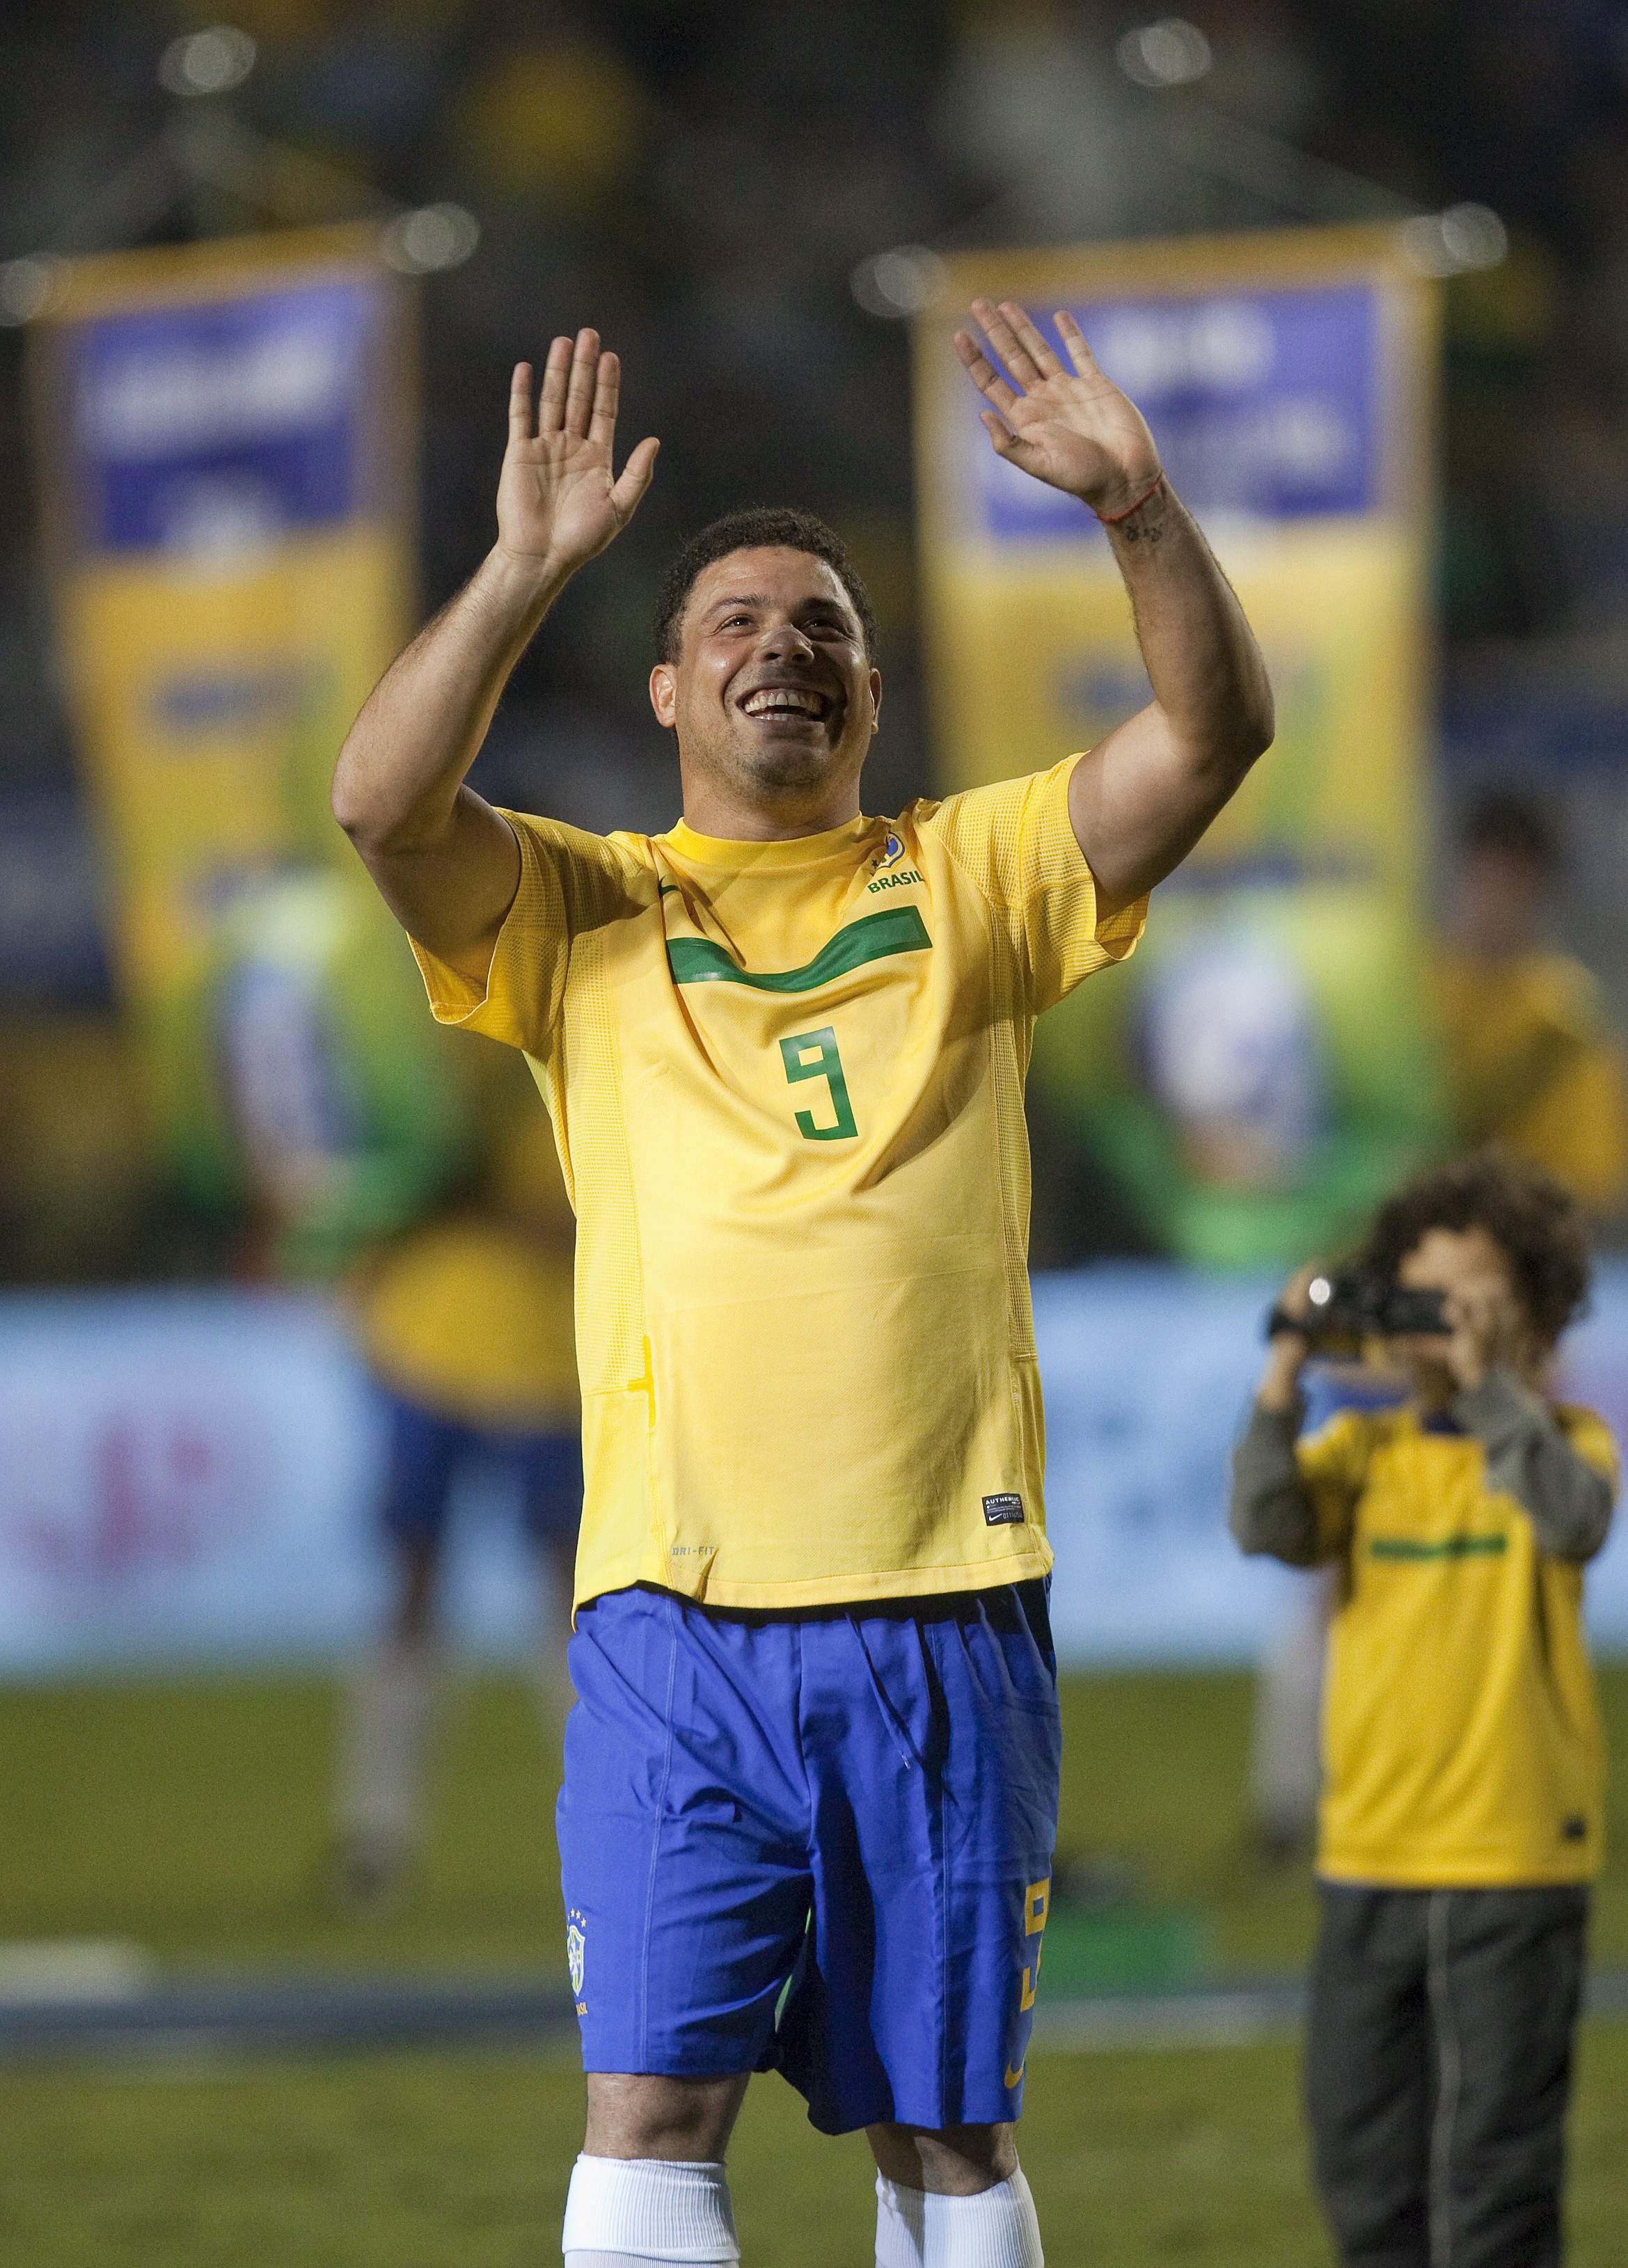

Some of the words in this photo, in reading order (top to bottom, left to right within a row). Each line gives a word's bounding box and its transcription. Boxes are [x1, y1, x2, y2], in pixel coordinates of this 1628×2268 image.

[867, 871, 925, 894] BRASIL
[779, 1026, 858, 1141] 9
[672, 1546, 715, 1555] DRI-FIT
